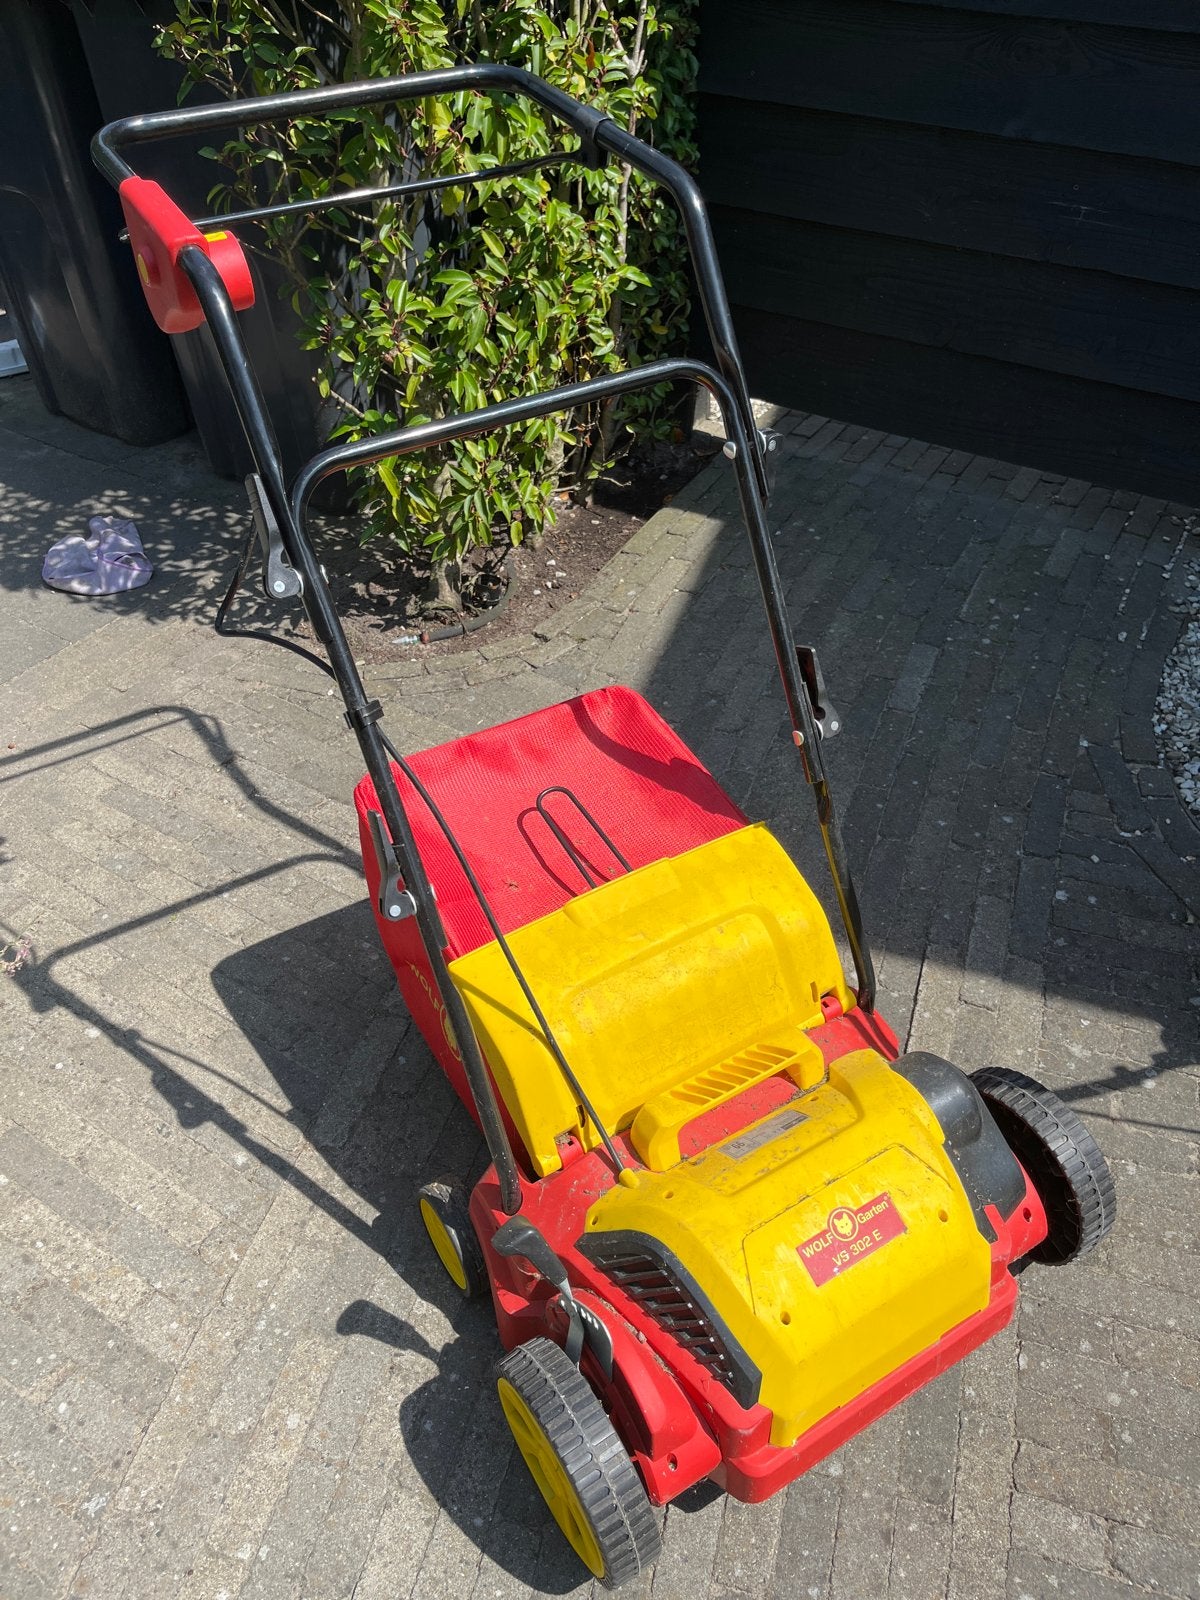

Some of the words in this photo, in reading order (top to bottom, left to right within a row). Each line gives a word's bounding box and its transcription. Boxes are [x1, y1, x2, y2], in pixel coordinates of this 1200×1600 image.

[802, 1232, 835, 1258] WOLF
[857, 1200, 889, 1224] Garten
[832, 1250, 850, 1266] VS
[850, 1235, 873, 1256] 302
[872, 1229, 883, 1241] E
